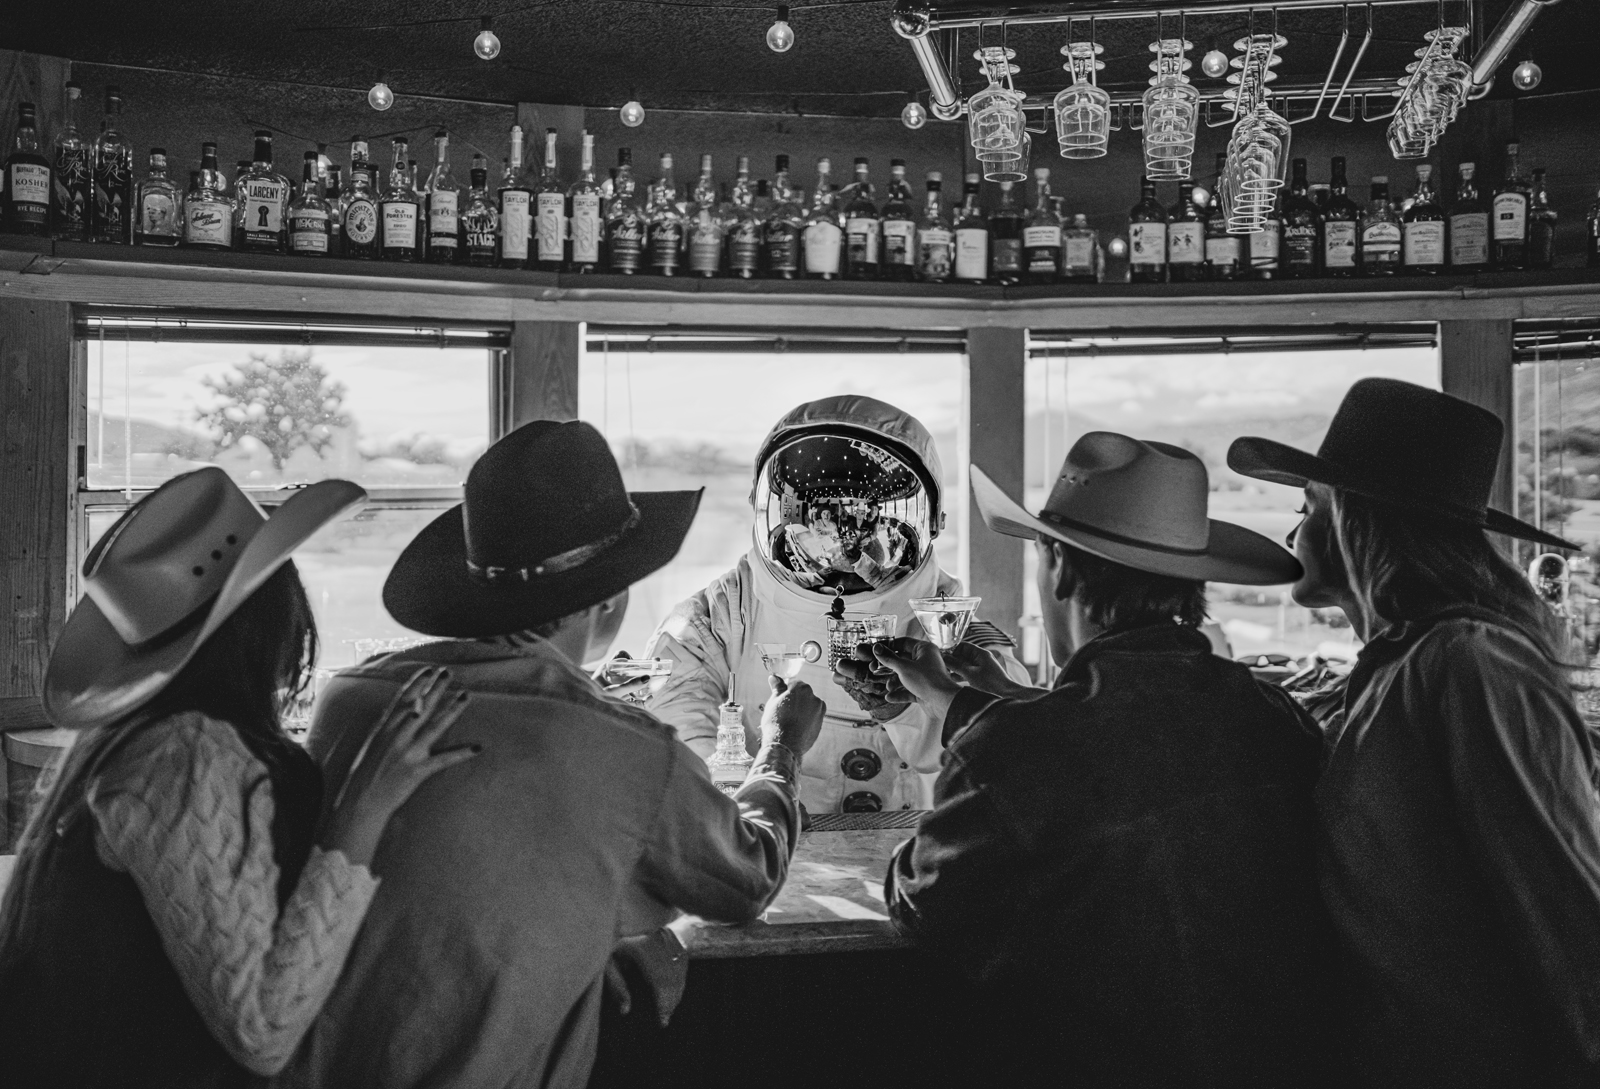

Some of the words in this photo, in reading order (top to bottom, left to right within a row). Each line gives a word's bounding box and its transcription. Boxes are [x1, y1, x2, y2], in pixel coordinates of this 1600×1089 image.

[15, 178, 48, 188] KOSHER
[249, 185, 279, 199] LARCENY
[504, 196, 528, 204] TAYLOR
[466, 233, 495, 247] STAGG
